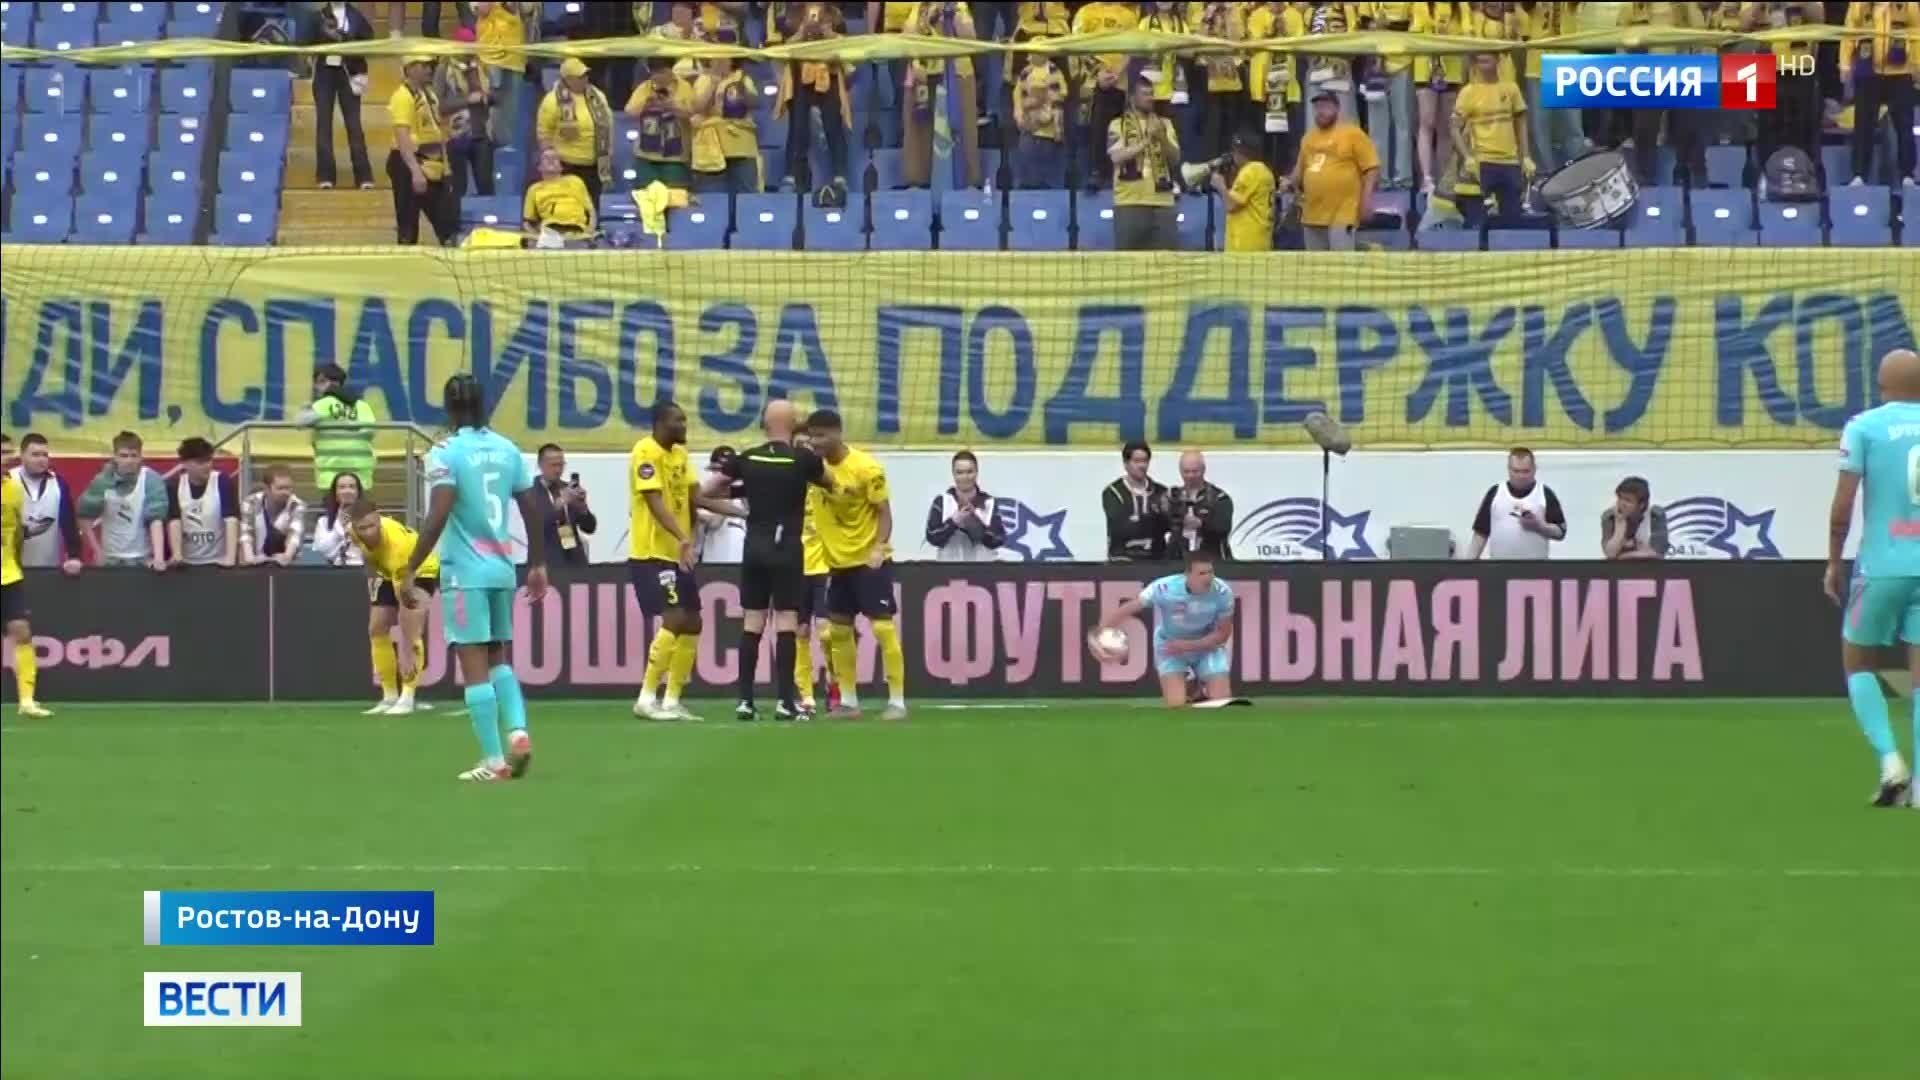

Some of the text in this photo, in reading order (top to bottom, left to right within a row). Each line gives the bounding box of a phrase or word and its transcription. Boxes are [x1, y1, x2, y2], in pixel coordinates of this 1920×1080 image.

[1, 298, 182, 428] ДИ,
[201, 297, 677, 430] СПАСИБО
[700, 303, 840, 433] ЗА
[877, 297, 1677, 445] ПОДДЕРЖКУ
[483, 471, 503, 533] 5
[1256, 545, 1290, 556] 104.1
[1664, 544, 1696, 556] 04.1
[923, 579, 1480, 685] ФУТБЛЬНАЯ
[1497, 578, 1704, 681] ЛИГА
